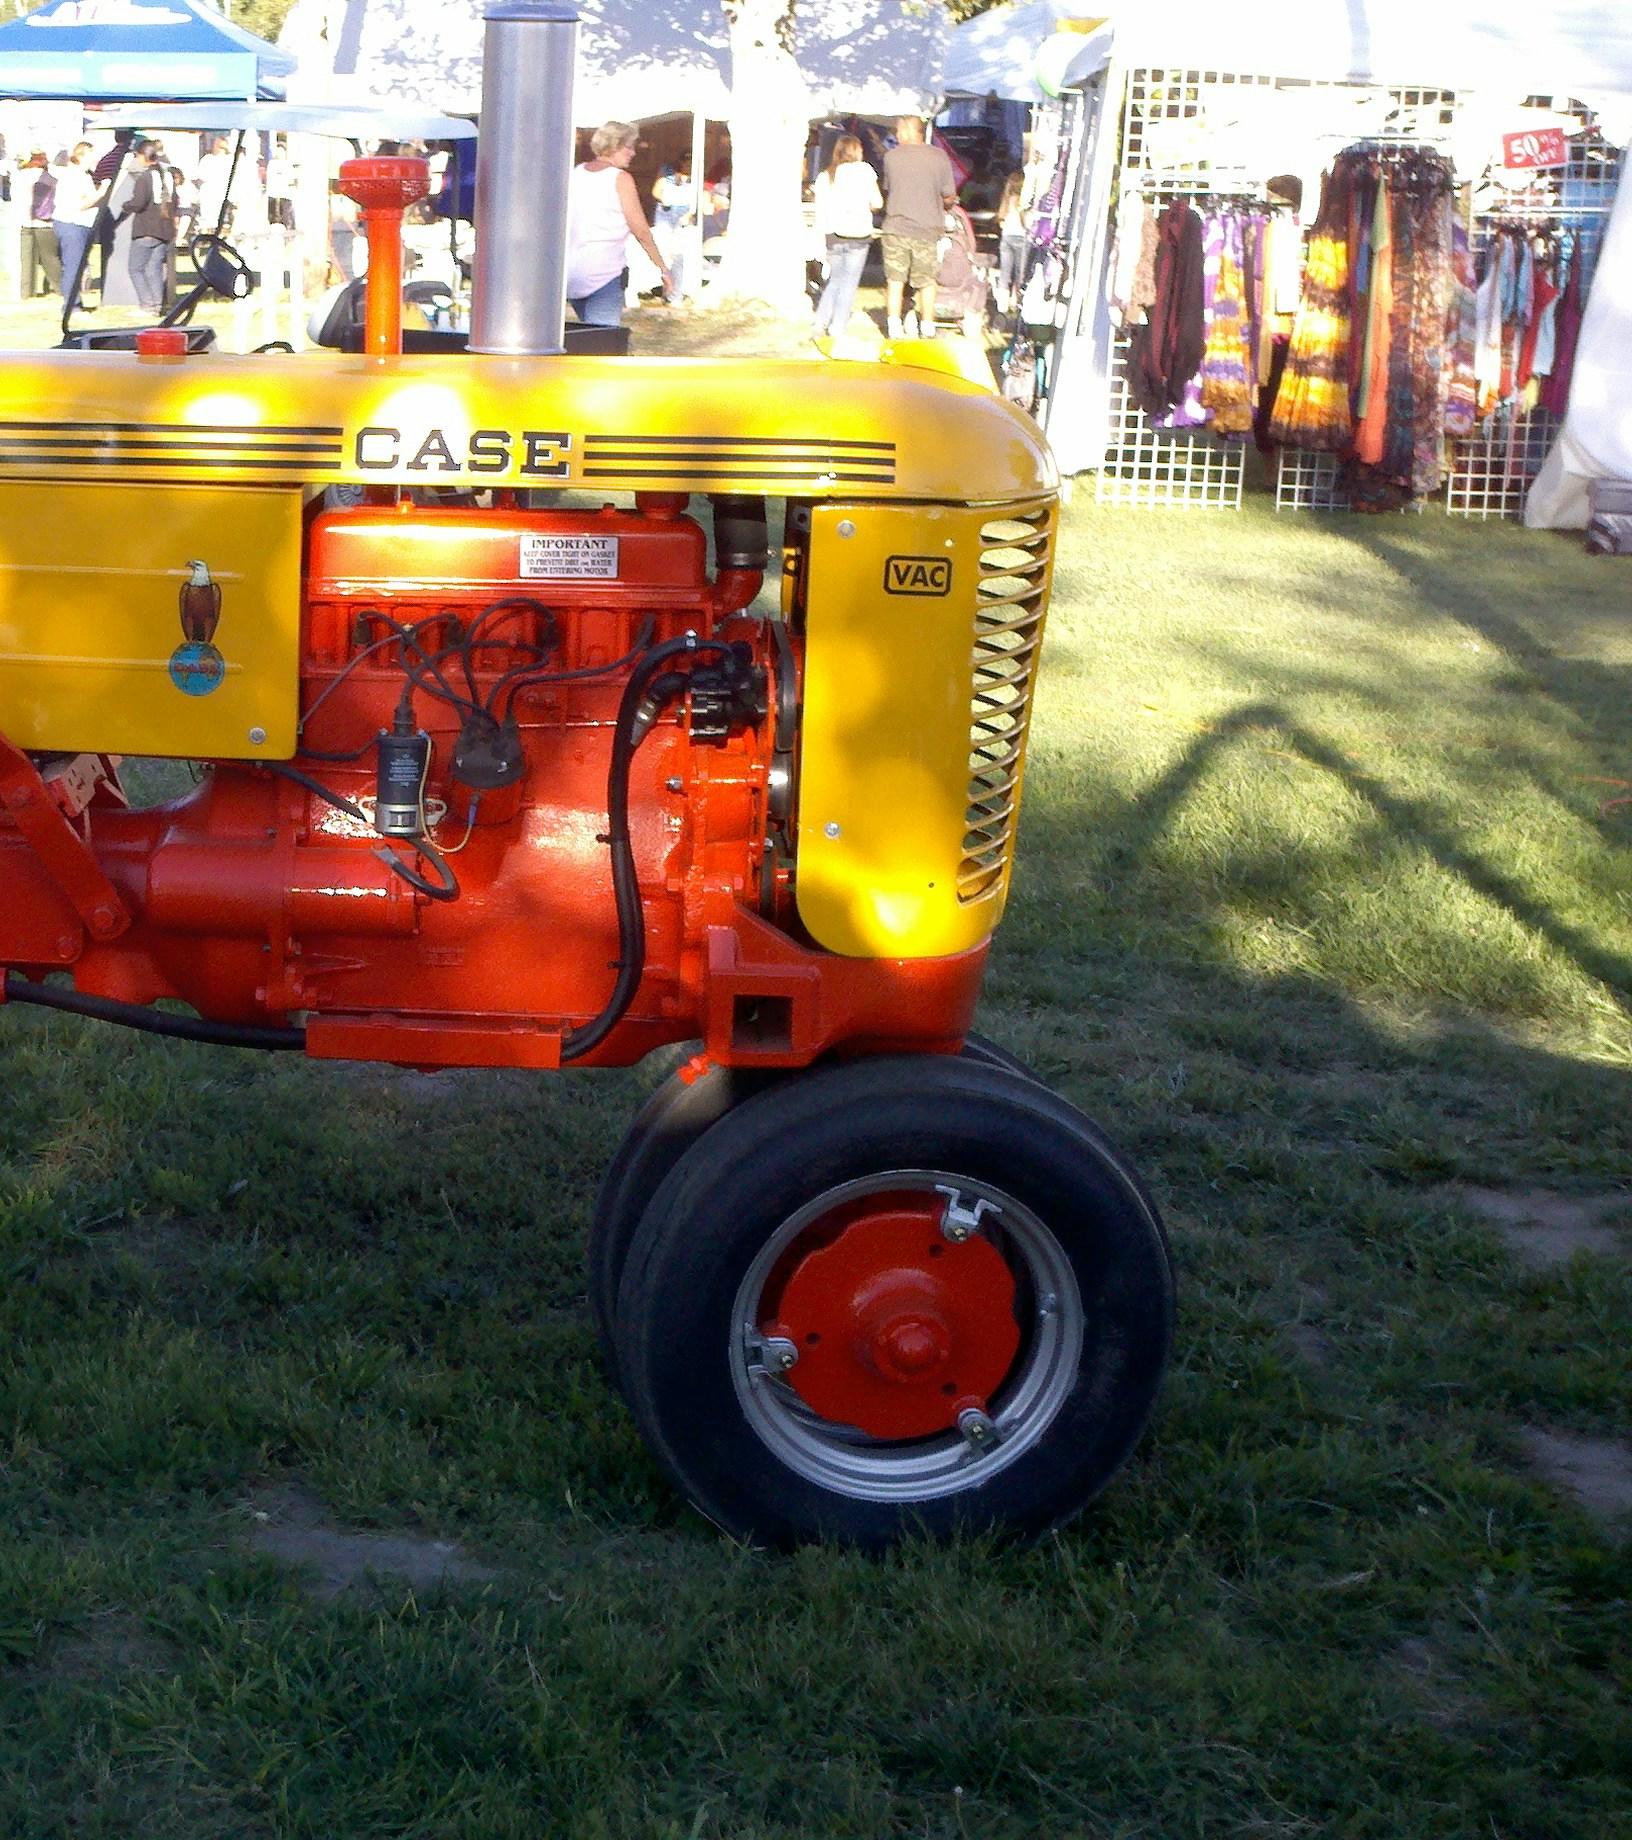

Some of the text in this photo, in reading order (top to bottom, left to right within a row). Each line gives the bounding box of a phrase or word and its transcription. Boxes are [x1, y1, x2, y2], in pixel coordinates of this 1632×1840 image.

[355, 427, 571, 477] CASE
[532, 540, 608, 549] IMPORTANT
[550, 567, 582, 575] ENTERING
[893, 564, 945, 588] VAC
